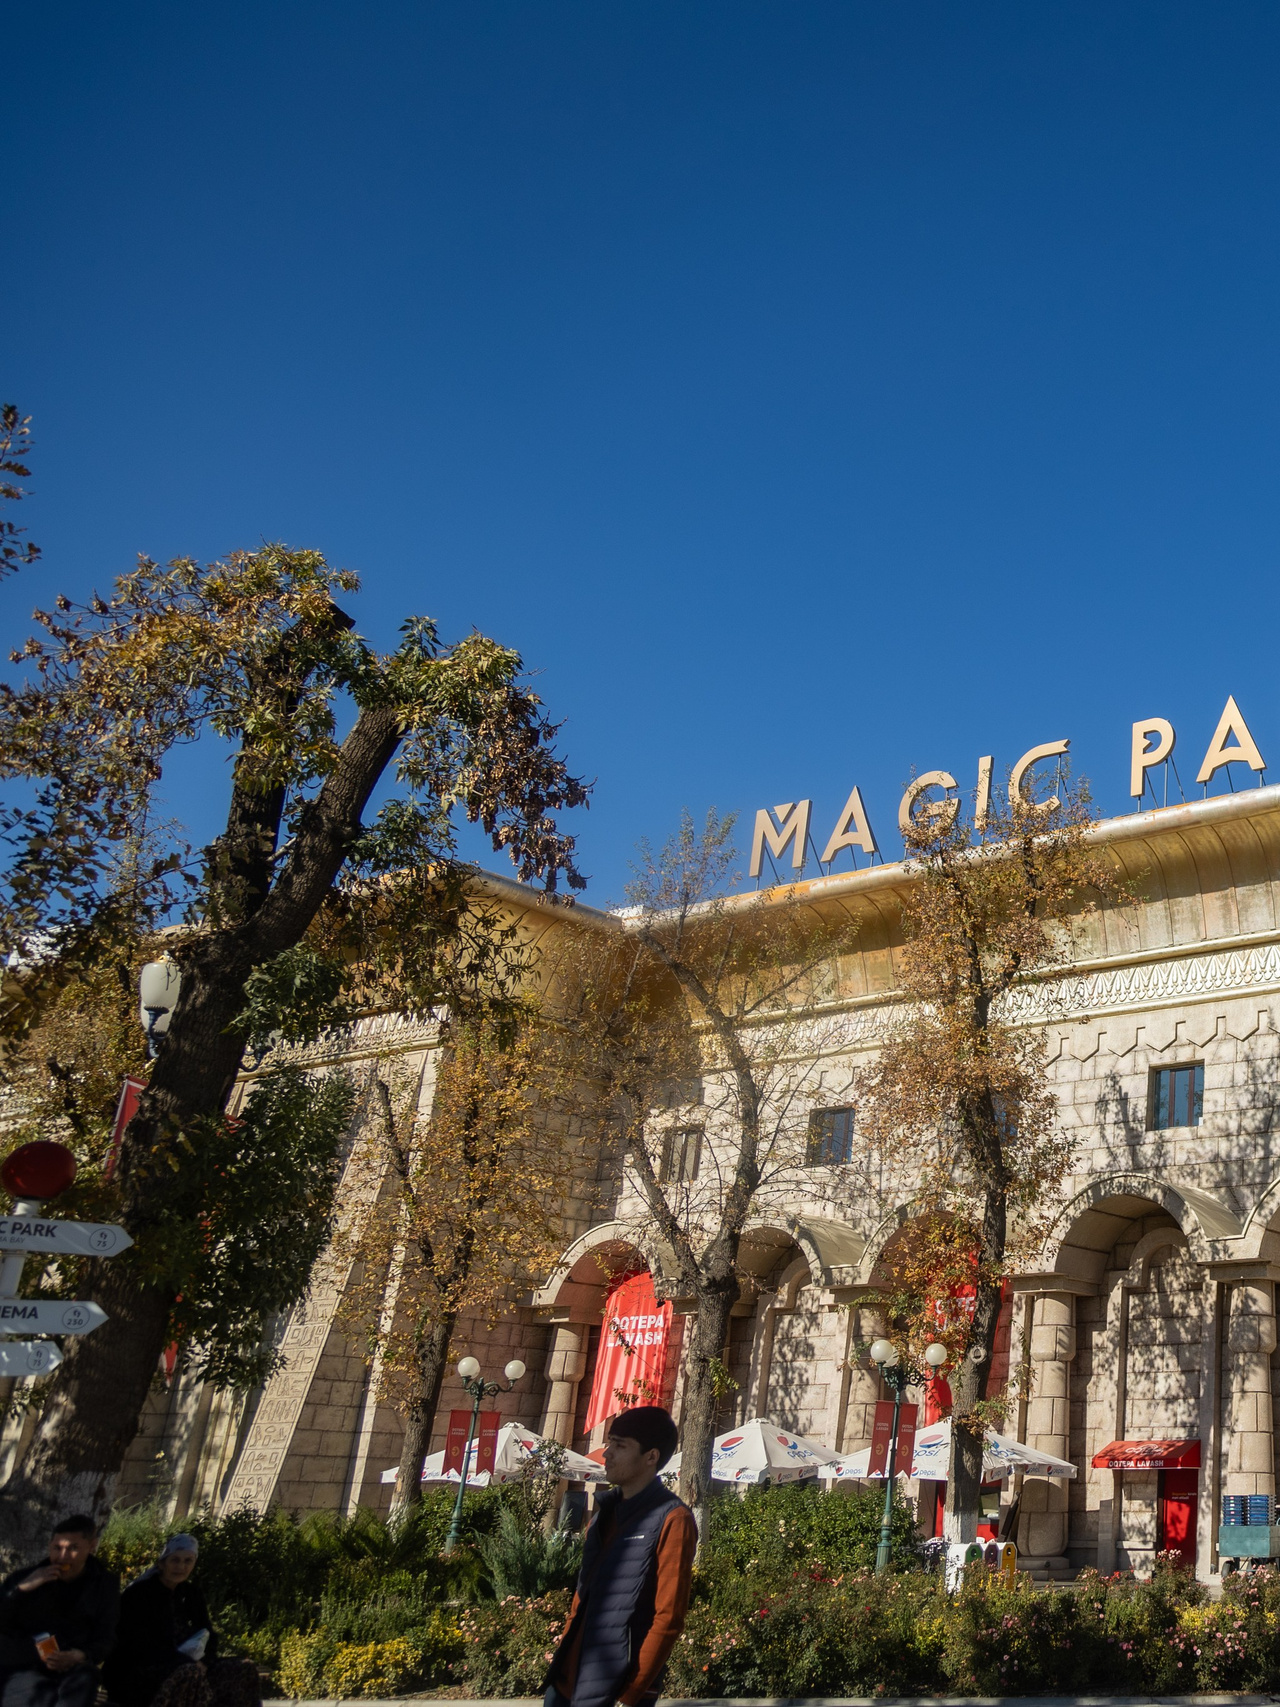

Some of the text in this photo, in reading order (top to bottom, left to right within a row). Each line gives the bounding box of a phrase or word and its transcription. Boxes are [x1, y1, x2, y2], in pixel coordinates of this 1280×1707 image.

[749, 739, 1069, 877] MAGIC
[11, 1222, 58, 1238] PARK
[0, 1306, 39, 1319] EMA
[1108, 1460, 1135, 1468] OQTEPA
[919, 1468, 936, 1476] pepsi
